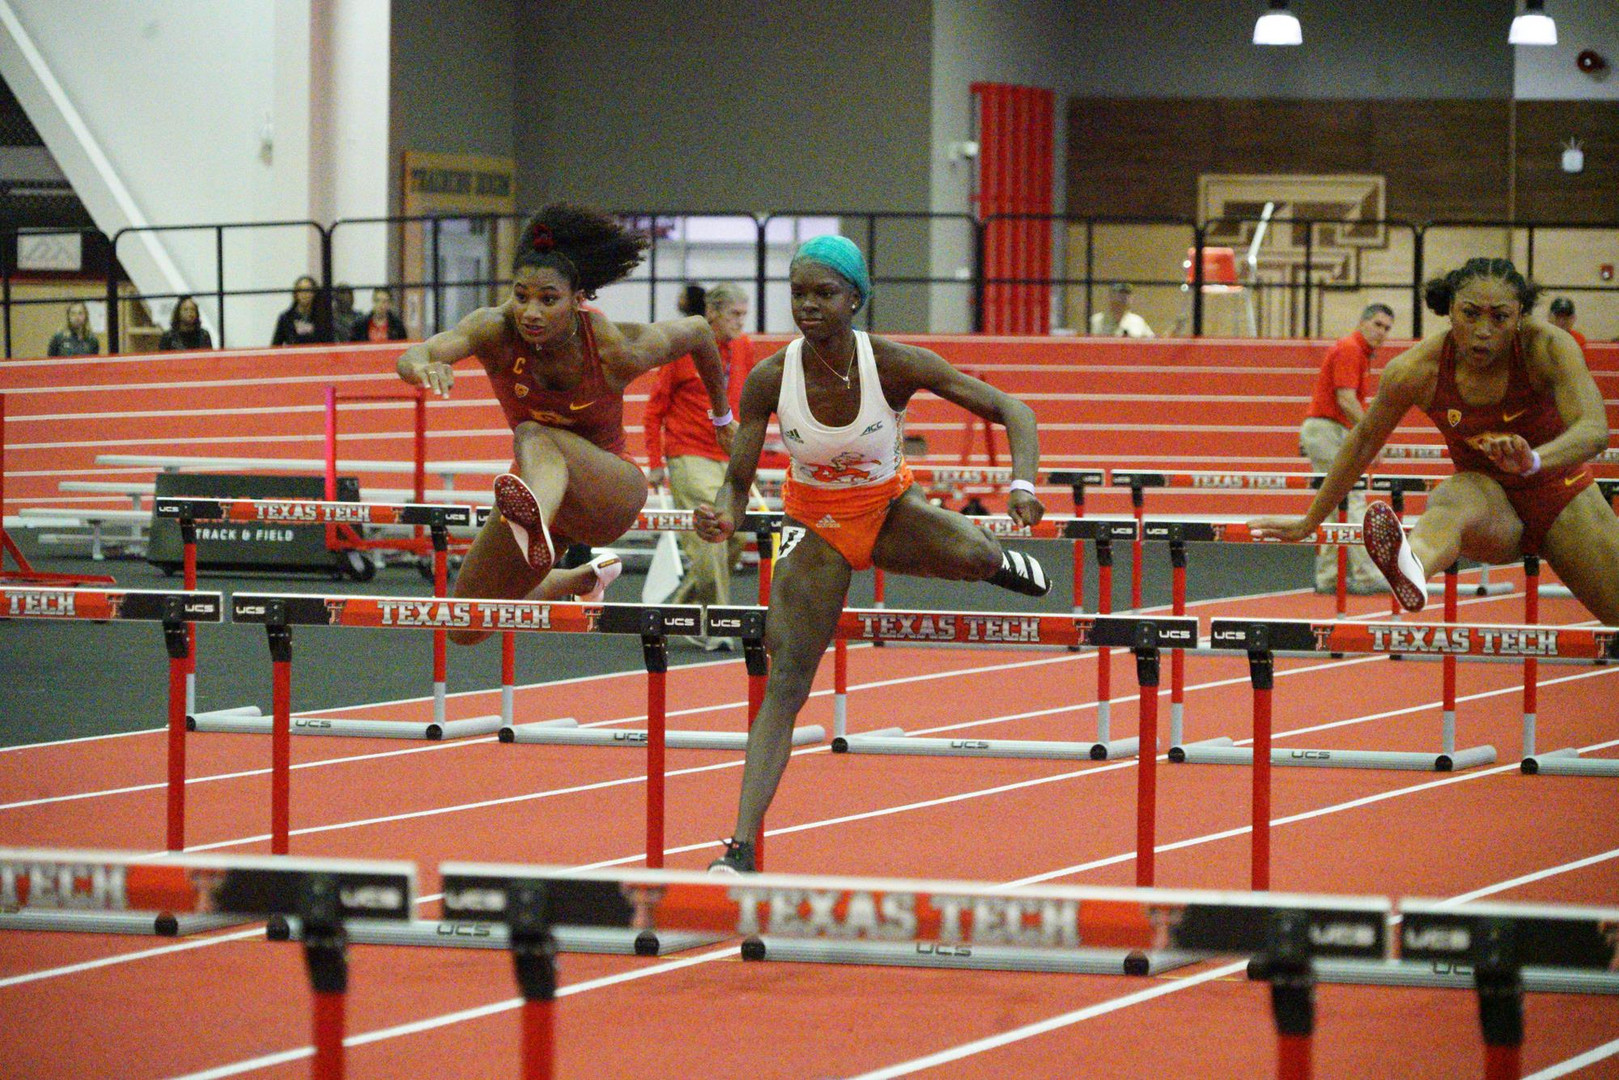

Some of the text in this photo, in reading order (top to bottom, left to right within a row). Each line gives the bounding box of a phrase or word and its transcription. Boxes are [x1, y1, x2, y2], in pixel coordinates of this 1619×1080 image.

[512, 356, 526, 375] C
[860, 420, 883, 437] ACC
[158, 505, 180, 513] UCS
[254, 503, 371, 522] TEXAS TECH
[445, 513, 466, 521] UCS
[643, 511, 694, 530] TECH
[195, 528, 237, 541] TRACK
[256, 529, 295, 542] FIELD
[1111, 527, 1133, 535] UCS
[1322, 526, 1362, 543] TEC
[5, 591, 76, 616] TECH
[185, 604, 214, 613] UCS
[235, 605, 265, 615] UCS
[377, 601, 551, 629] TEXAS TECH
[664, 617, 695, 627] UCS
[710, 619, 741, 628] UCS
[858, 613, 1040, 642] TEXAS TECH
[1158, 630, 1191, 639] UCS
[1214, 631, 1246, 640] UCS
[1368, 625, 1558, 656] TEXAS TECH
[295, 719, 331, 728] UCS
[951, 740, 989, 749] UCS
[1291, 750, 1331, 759] UCS
[0, 863, 126, 910] TECH
[340, 886, 400, 909] UCS
[446, 889, 506, 911] UCS
[727, 886, 1081, 948] TEXAS TECH
[436, 923, 491, 938] UCS
[1309, 925, 1375, 947] UCS
[1405, 928, 1471, 950] UCS
[916, 942, 972, 957] UCS
[1433, 959, 1472, 975] UC
